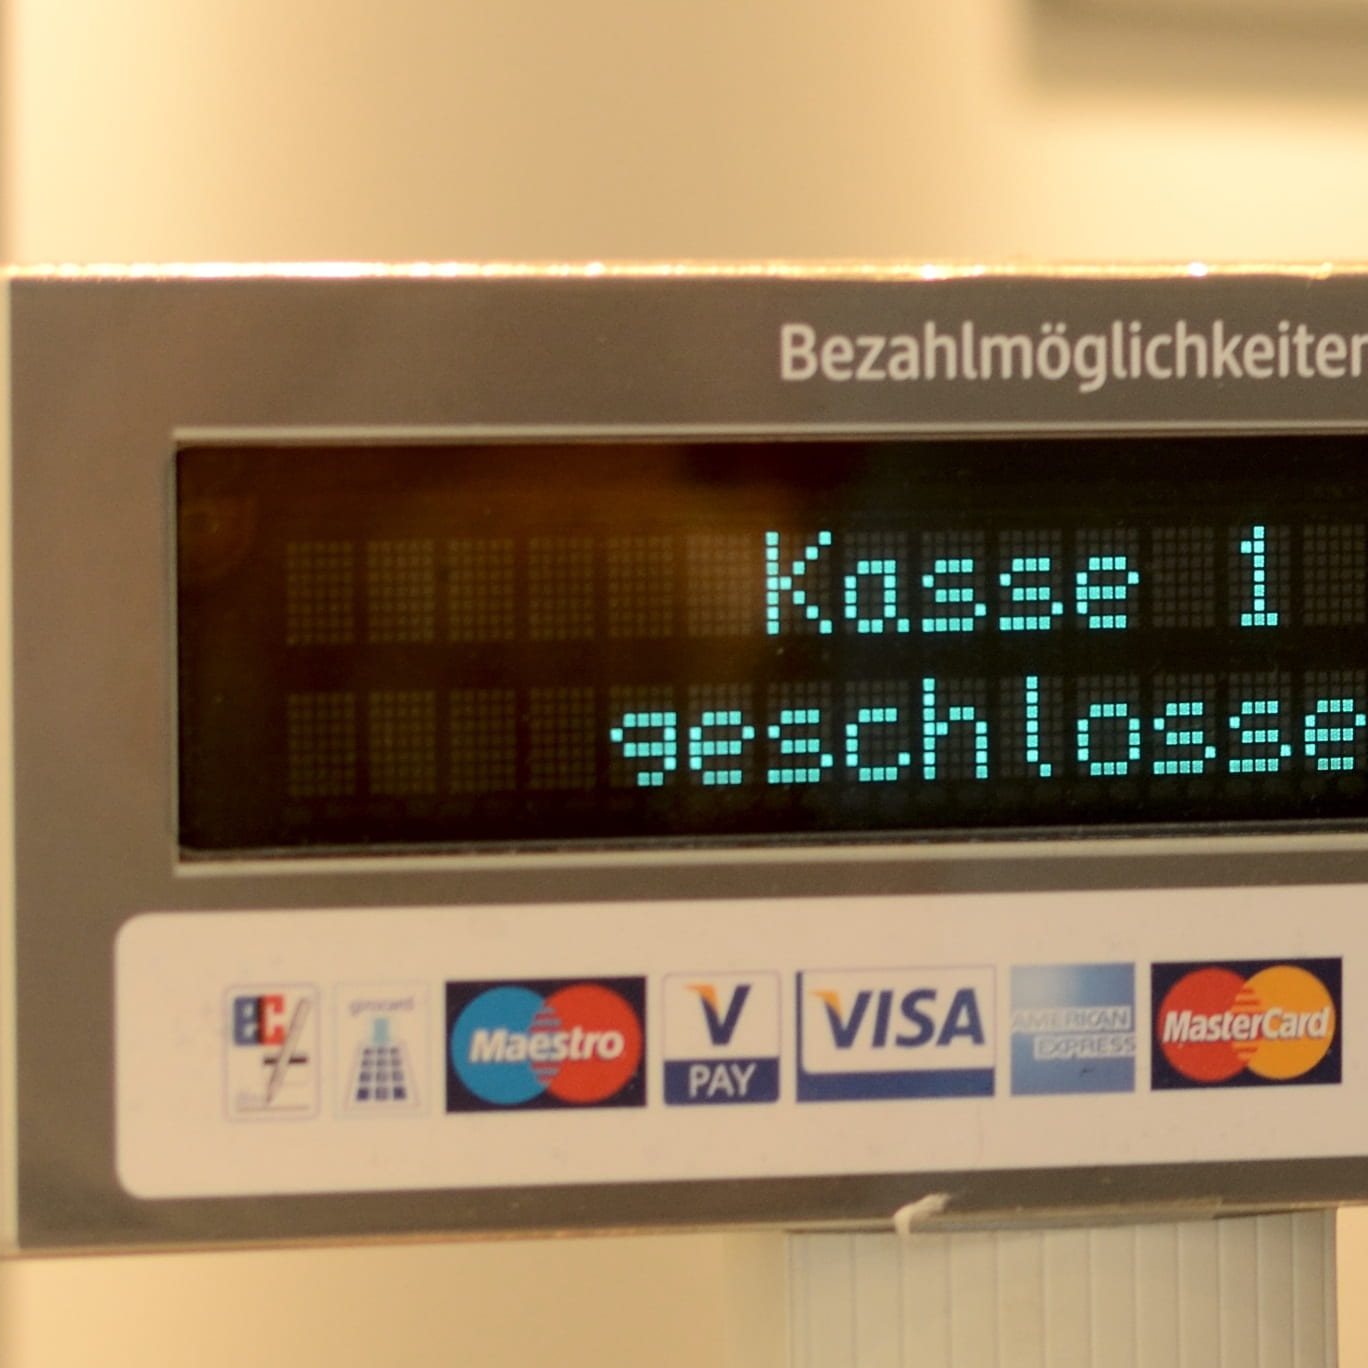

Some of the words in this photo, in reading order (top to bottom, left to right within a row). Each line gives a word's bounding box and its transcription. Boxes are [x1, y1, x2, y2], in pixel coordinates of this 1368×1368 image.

[764, 529, 1140, 635] Kasse
[1239, 524, 1280, 627] 1
[684, 983, 753, 1048] V
[808, 987, 985, 1050] VISA
[1011, 1005, 1131, 1035] AMERICAN
[1162, 1005, 1331, 1044] MasterCard
[468, 1026, 625, 1064] Maestro
[1034, 1033, 1137, 1060] EXPRESS
[688, 1061, 757, 1100] PAY
